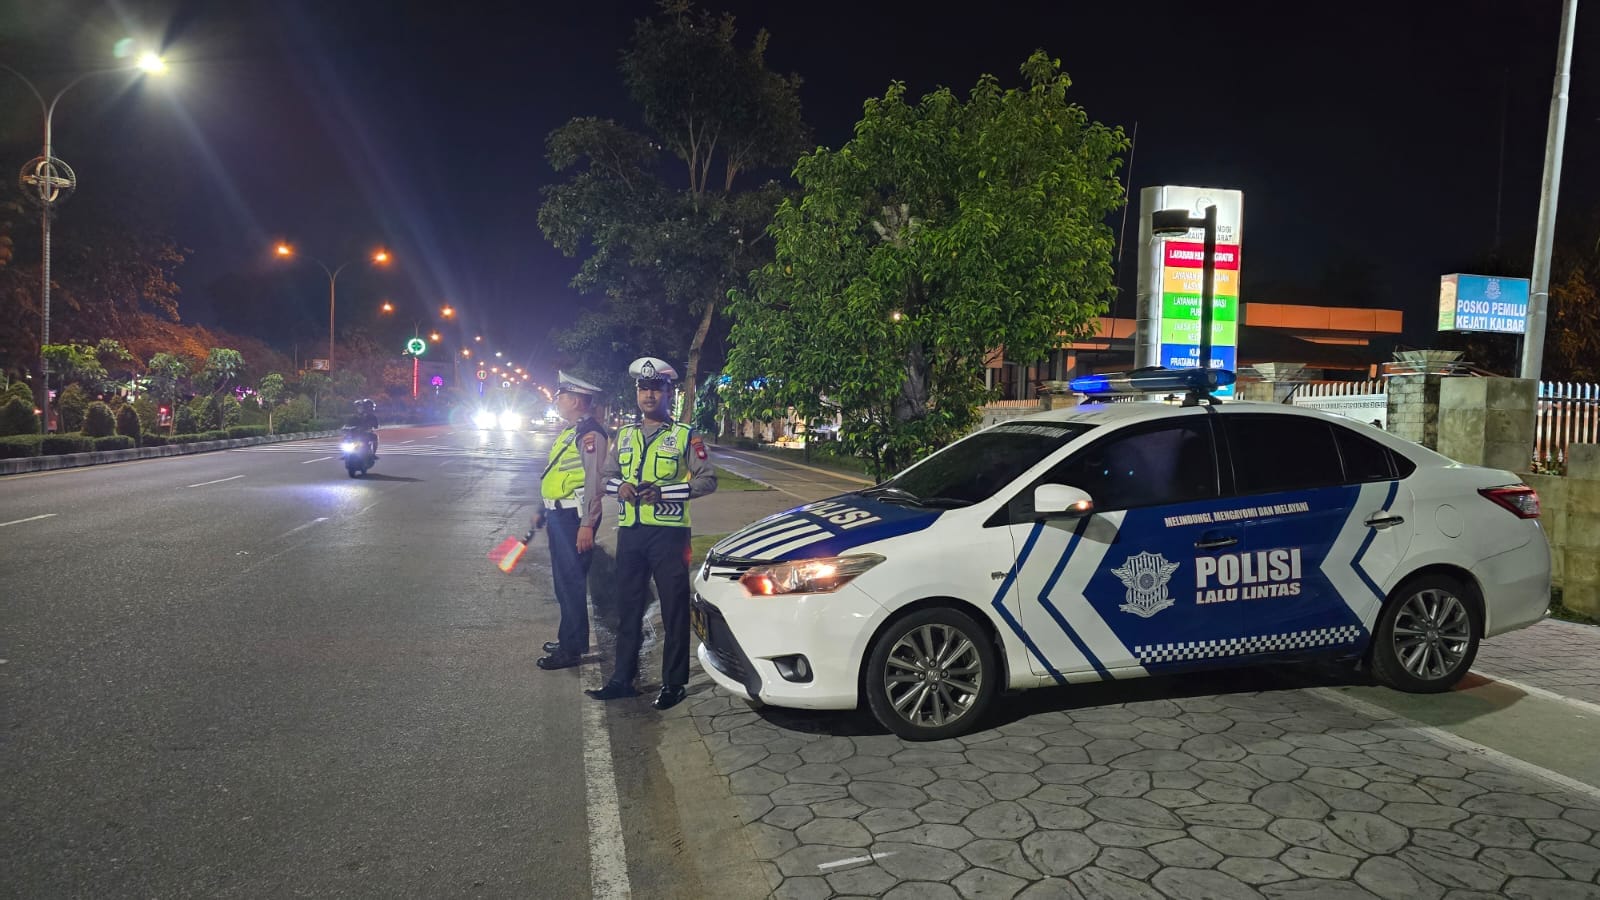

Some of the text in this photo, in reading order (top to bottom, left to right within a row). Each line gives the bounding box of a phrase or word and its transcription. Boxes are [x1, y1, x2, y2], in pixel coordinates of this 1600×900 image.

[1174, 296, 1198, 306] LAYANAN
[1457, 299, 1526, 316] POSKO PEMILU
[1456, 315, 1525, 332] KEJATI KALBAR
[1164, 501, 1309, 527] MELINDUNGI, MENGAYOMI DAN MELAYANI
[1195, 548, 1302, 588] POLISI
[1196, 582, 1301, 605] LALU LINTAS
